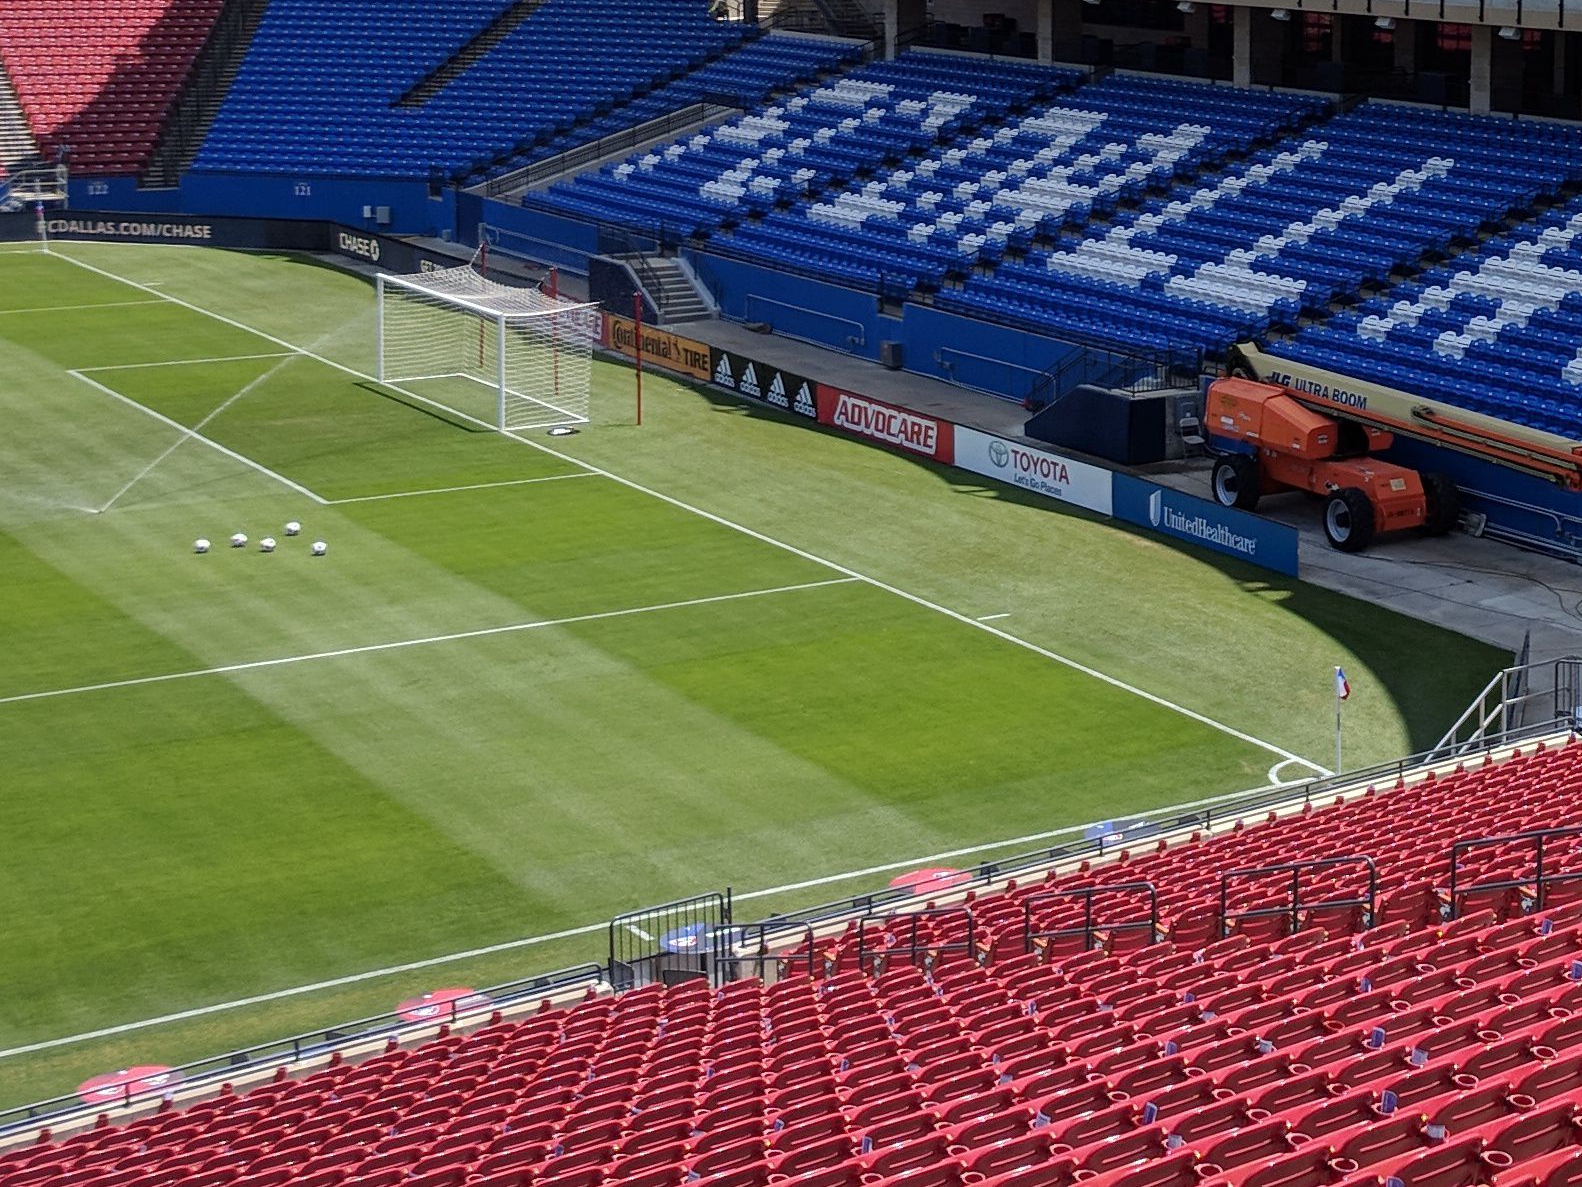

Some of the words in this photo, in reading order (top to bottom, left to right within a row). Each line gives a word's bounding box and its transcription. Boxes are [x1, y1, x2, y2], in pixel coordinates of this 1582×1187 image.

[340, 232, 371, 258] CHASE
[683, 346, 710, 373] TIRE
[714, 372, 735, 389] adidas
[740, 381, 761, 398] adidas
[1270, 370, 1292, 387] JLG
[1295, 377, 1330, 399] ULTRA
[1331, 387, 1369, 411] BOOM
[767, 391, 789, 408] adidas
[794, 401, 816, 418] adidas
[836, 397, 936, 452] ADVOCARE
[1011, 448, 1070, 486] TOYOTA
[1013, 473, 1029, 487] Let's
[1029, 478, 1041, 490] Go
[1040, 481, 1062, 497] Places
[1163, 506, 1256, 556] UnitedHealthcare
